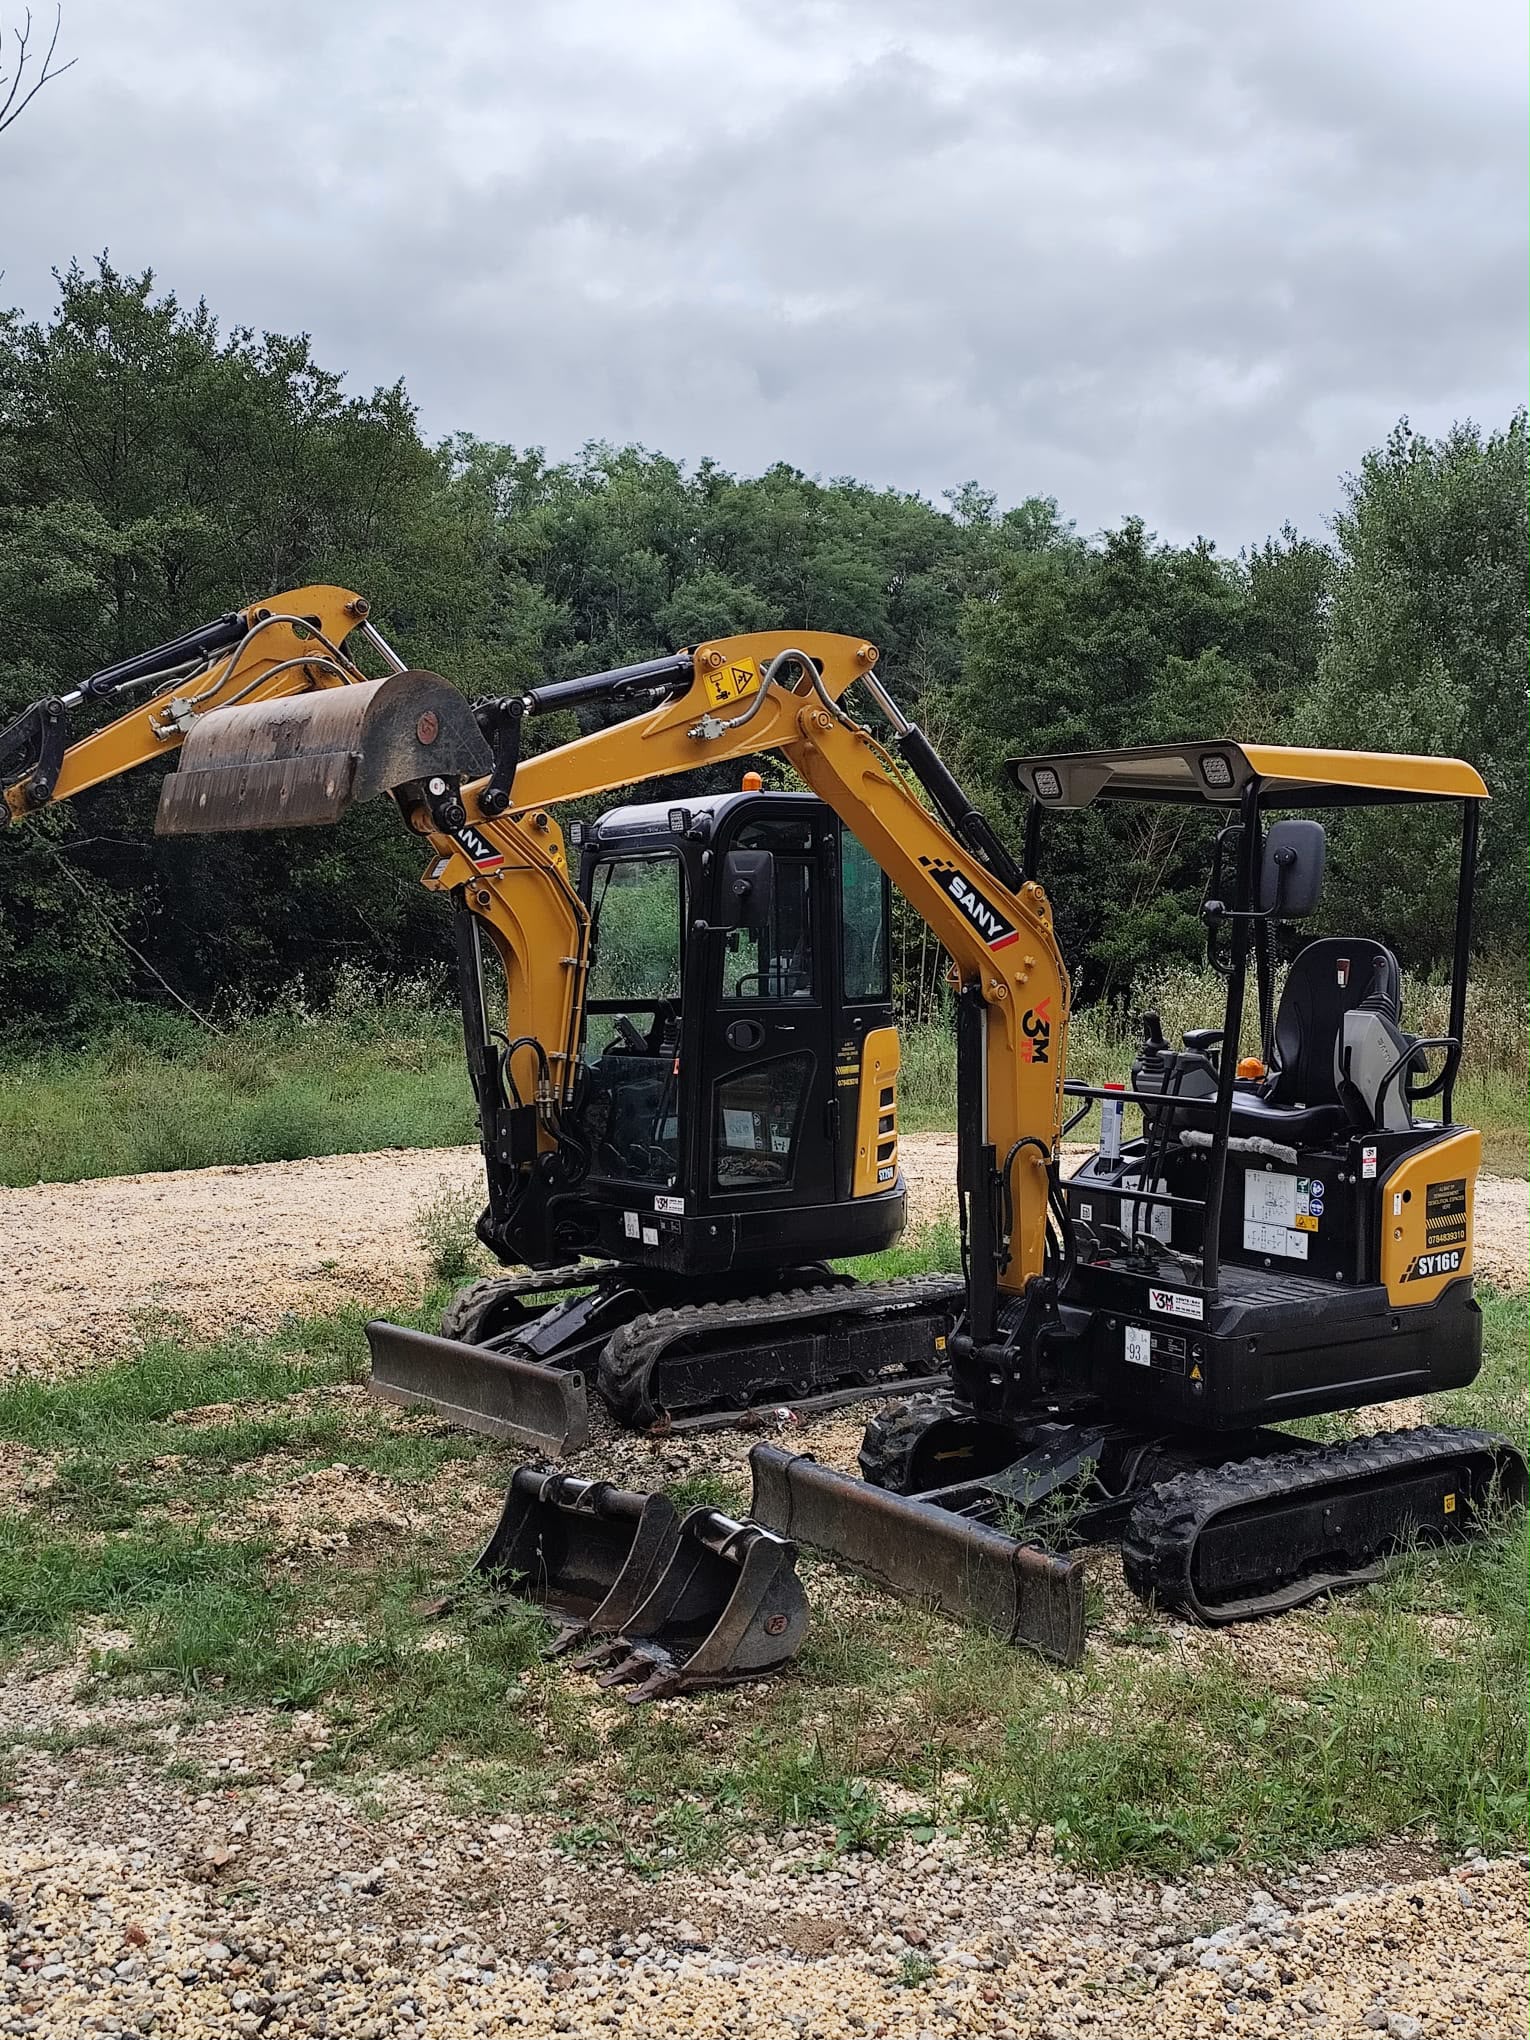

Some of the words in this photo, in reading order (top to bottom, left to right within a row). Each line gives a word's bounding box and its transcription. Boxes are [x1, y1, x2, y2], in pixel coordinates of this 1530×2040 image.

[947, 876, 1004, 938] SANY
[1022, 997, 1051, 1064] V3M
[1418, 1251, 1460, 1275] SY16C
[1151, 1291, 1174, 1309] V3M
[1129, 1343, 1141, 1361] 93
